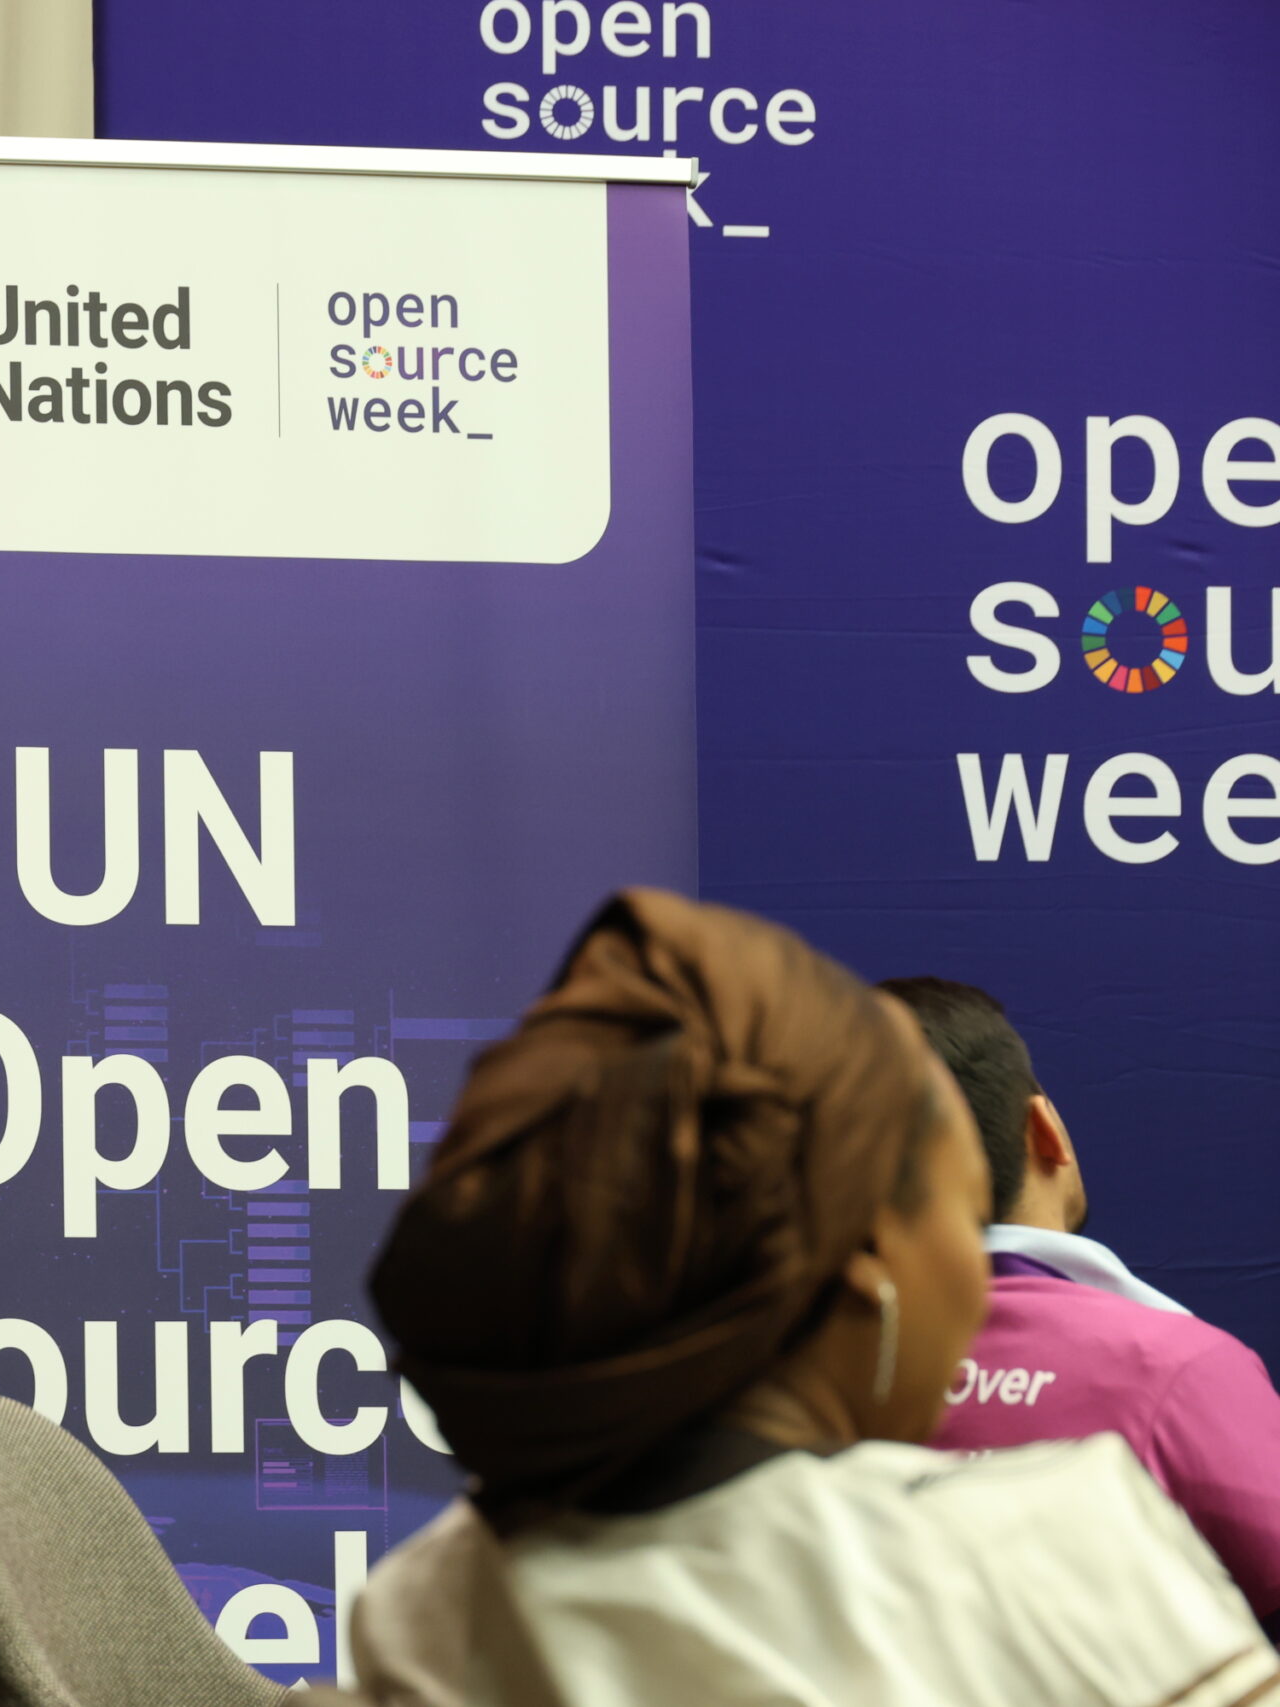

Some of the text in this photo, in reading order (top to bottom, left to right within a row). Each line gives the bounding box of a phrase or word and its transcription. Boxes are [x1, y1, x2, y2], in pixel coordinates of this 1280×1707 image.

[479, 0, 712, 75] open
[481, 82, 817, 146] source
[327, 291, 459, 339] open
[329, 344, 519, 383] source
[326, 386, 494, 440] week_
[961, 412, 1280, 563] ope
[15, 746, 296, 927] UN
[955, 751, 1280, 866] wee
[943, 1358, 1057, 1406] Over
